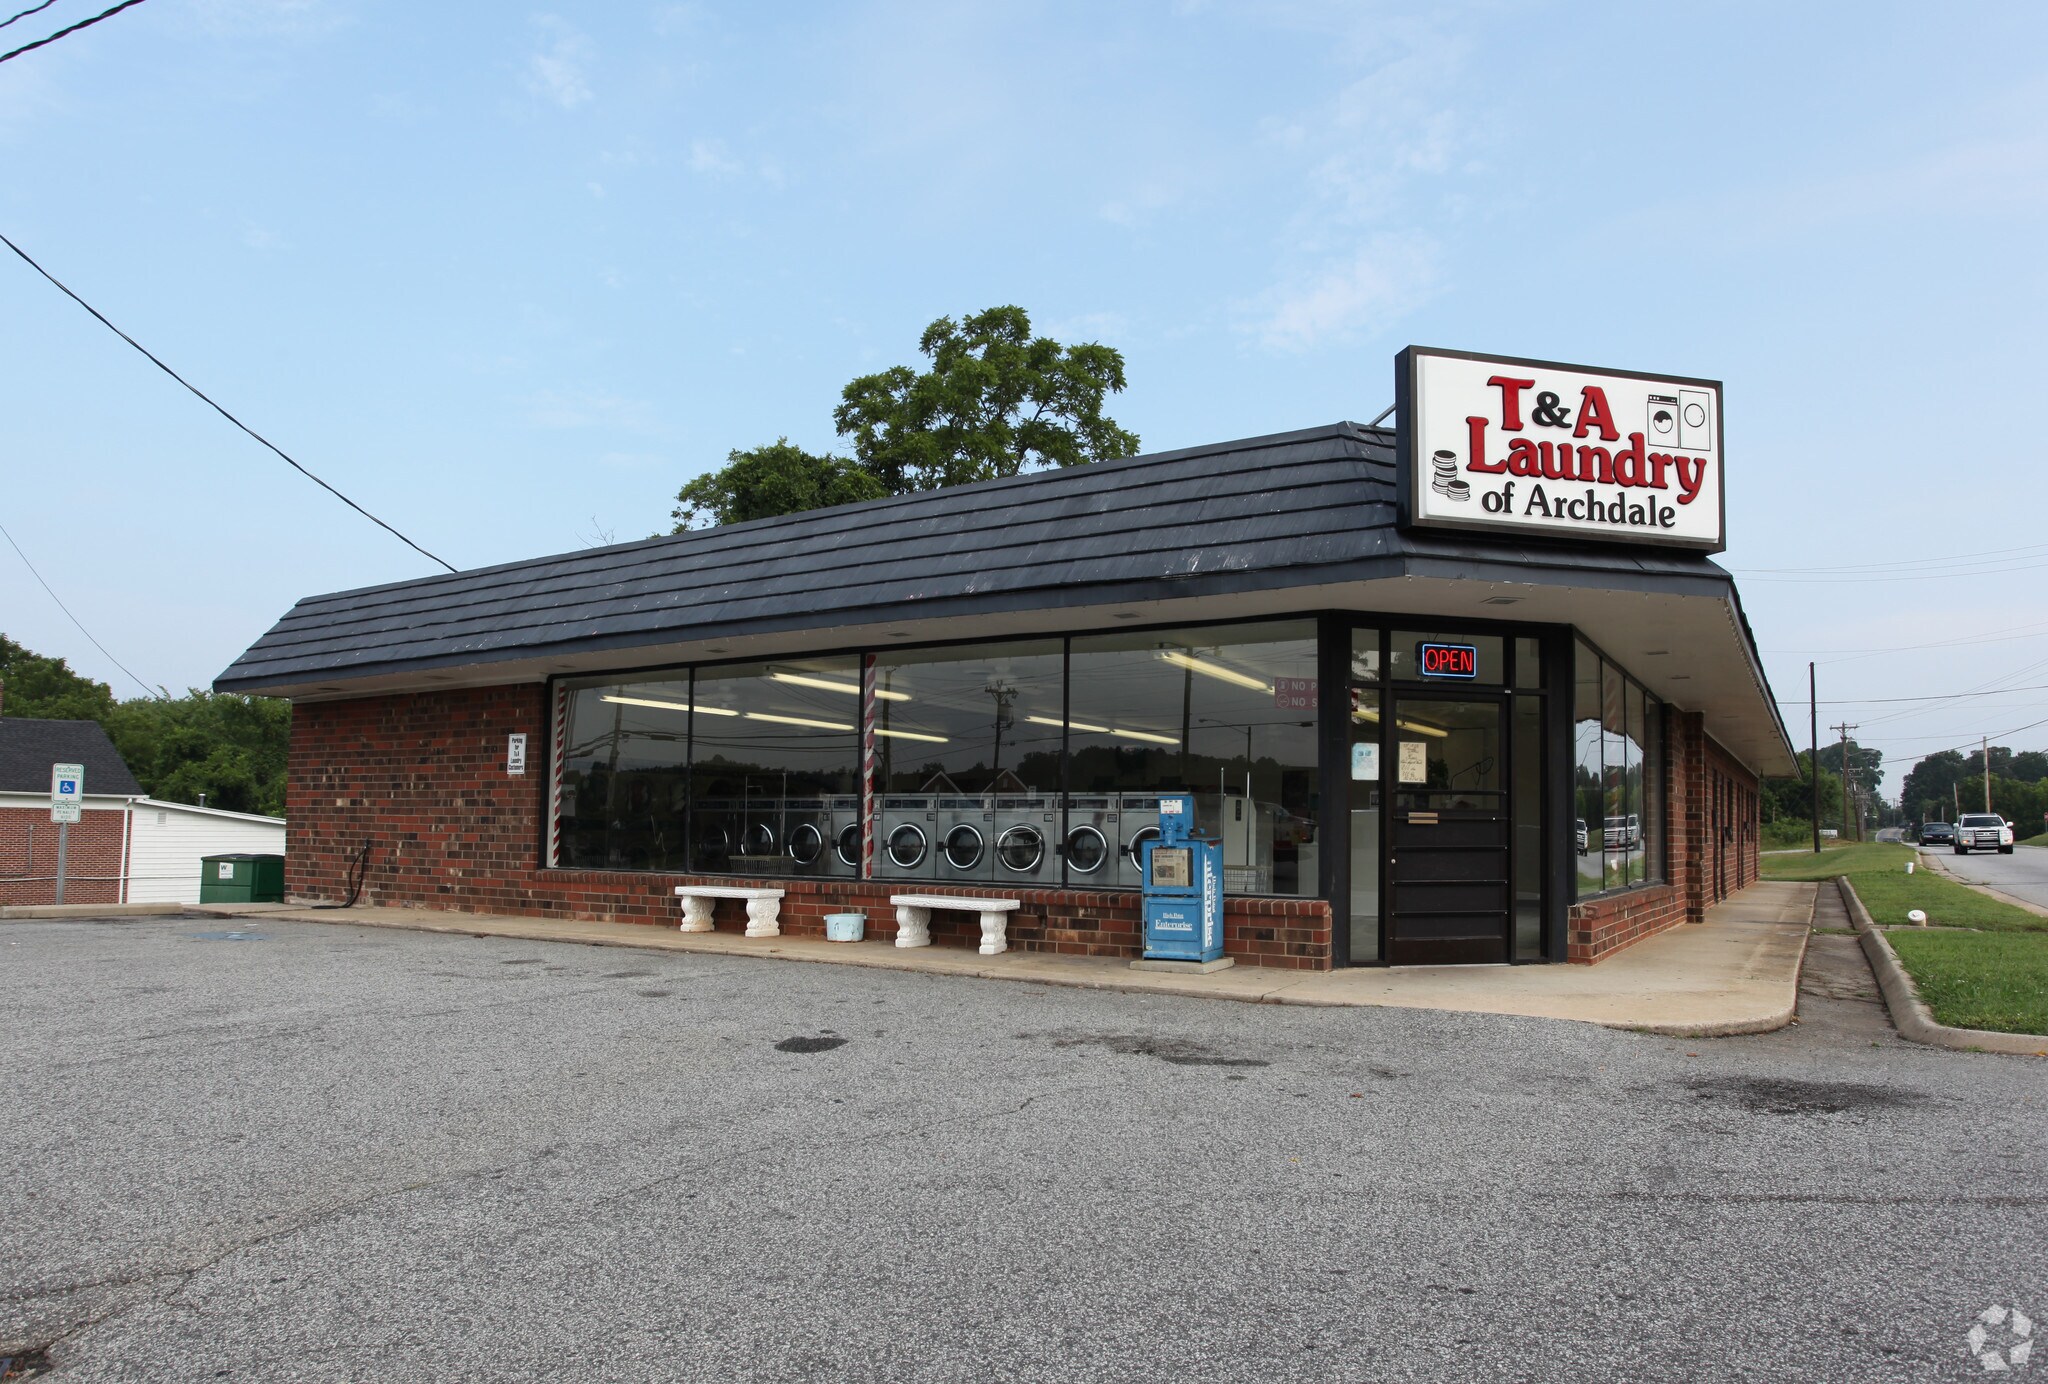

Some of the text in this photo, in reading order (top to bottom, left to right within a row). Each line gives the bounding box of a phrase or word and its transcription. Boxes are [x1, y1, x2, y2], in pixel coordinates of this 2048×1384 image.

[1486, 375, 1620, 442] T&A
[1465, 415, 1708, 506] Laundry
[1481, 480, 1677, 529] of Archdale
[1425, 648, 1473, 672] OPEN
[1292, 681, 1306, 690] NO
[1292, 698, 1306, 706] NO
[1155, 919, 1193, 930] Enterprise
